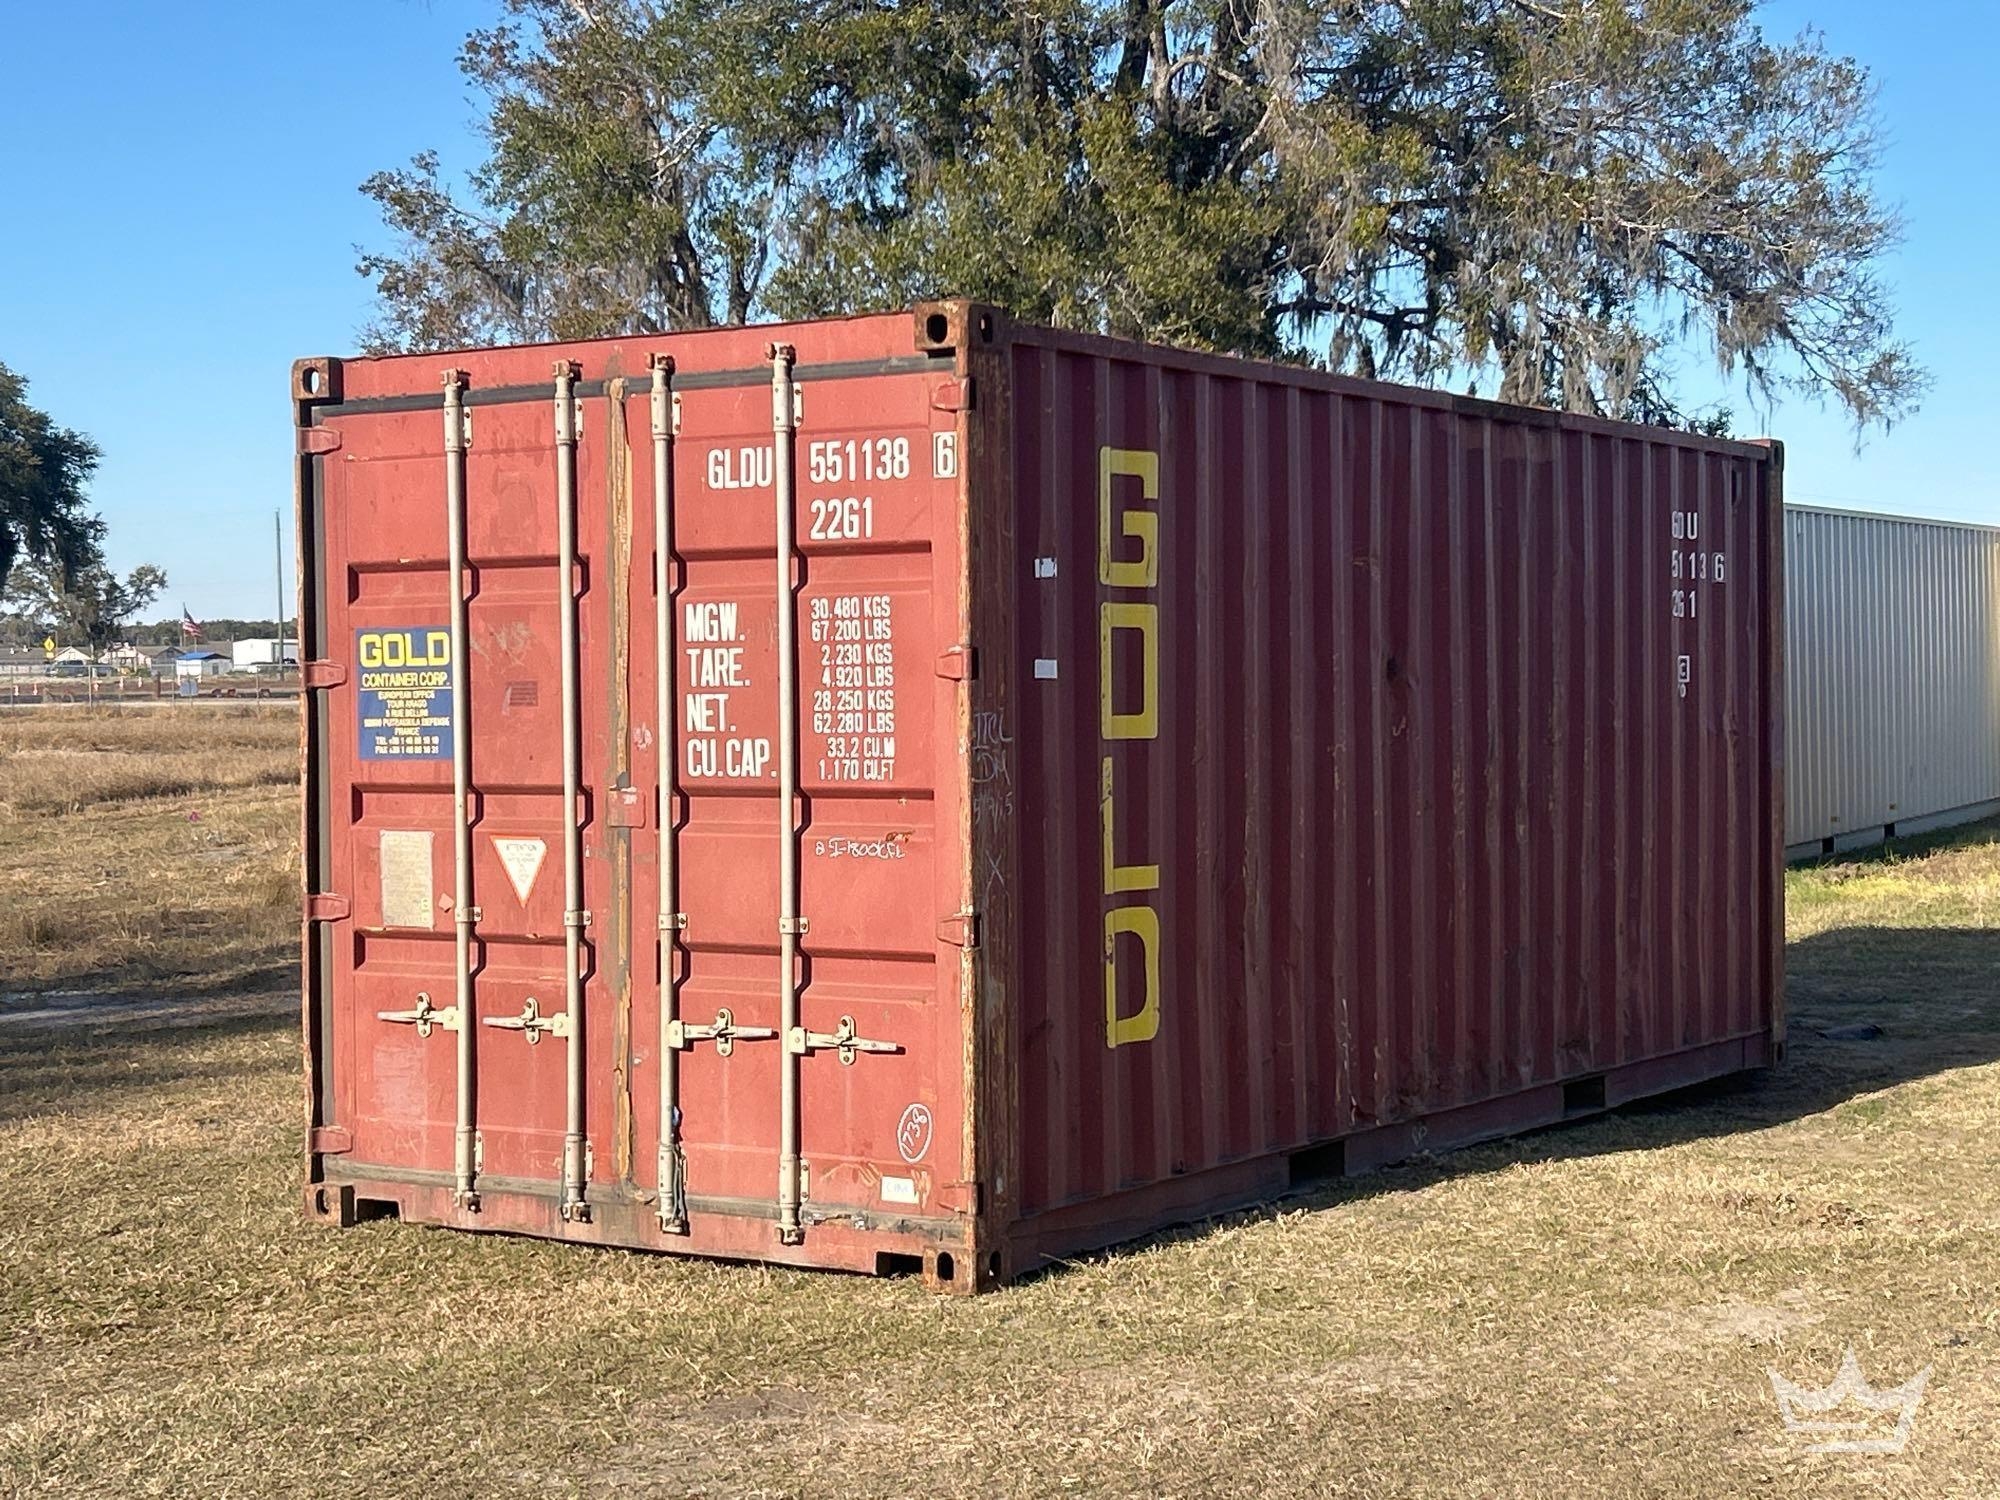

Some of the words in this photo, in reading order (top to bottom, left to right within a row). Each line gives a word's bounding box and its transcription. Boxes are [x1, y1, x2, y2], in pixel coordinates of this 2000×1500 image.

[707, 447, 773, 489] GLDU
[810, 438, 910, 483] 551138
[934, 433, 956, 477] 6
[810, 498, 873, 540] 22G1
[686, 603, 745, 642] MGW.
[811, 598, 861, 619] 30.480
[864, 596, 891, 618] KGS
[811, 619, 861, 641] 67.200
[865, 618, 891, 640] LBS
[360, 632, 450, 667] GOLD
[686, 648, 751, 687] TARE.
[821, 644, 861, 665] 2.230
[865, 643, 893, 664] KGS
[362, 672, 418, 687] CONTAINER
[822, 667, 862, 688] 4.920
[867, 666, 894, 687] LBS
[686, 693, 737, 732] NET.
[813, 691, 862, 712] 28.250
[867, 690, 894, 711] KGS
[813, 713, 862, 734] 62.280
[867, 712, 895, 733] LBS
[687, 738, 777, 777] CU.CAP.
[827, 737, 860, 759] 33.2
[864, 737, 895, 758] CU.M
[1100, 445, 1160, 1048] GOLD
[819, 759, 860, 781] 1.170
[899, 1107, 928, 1155] 1738
